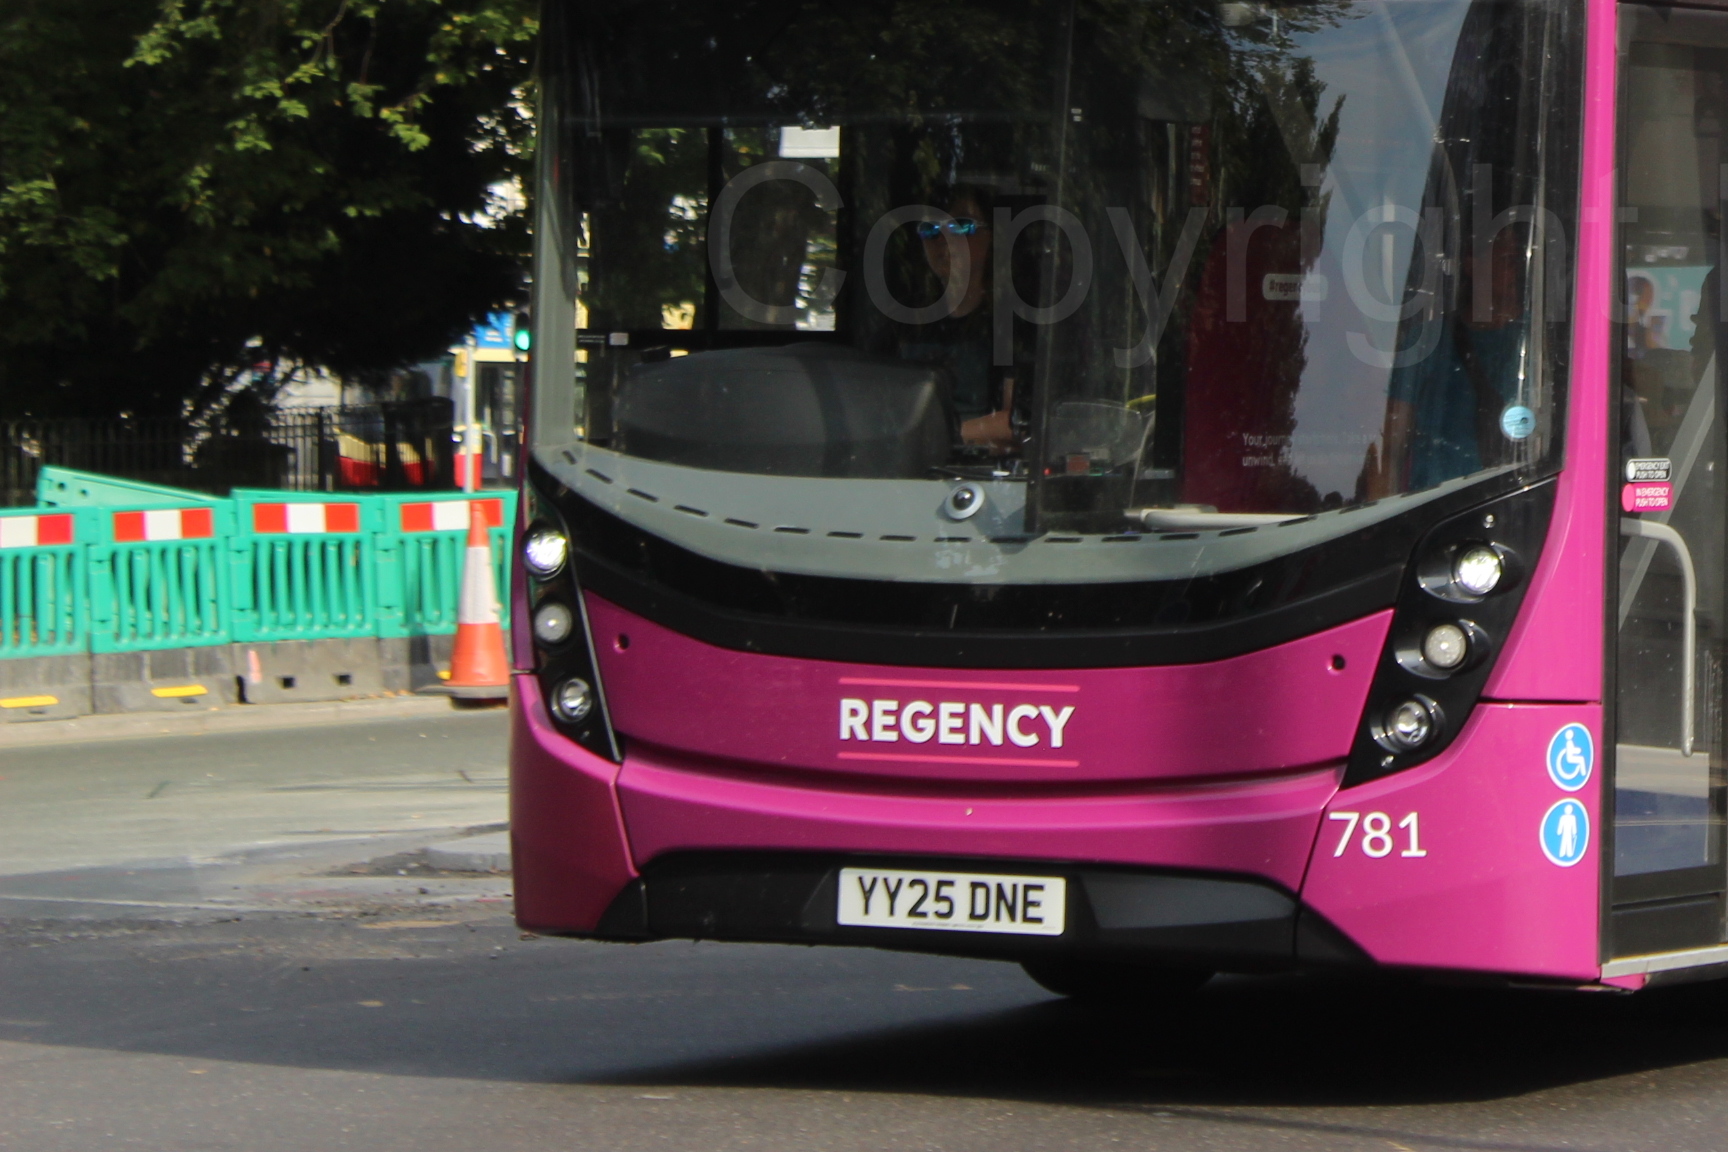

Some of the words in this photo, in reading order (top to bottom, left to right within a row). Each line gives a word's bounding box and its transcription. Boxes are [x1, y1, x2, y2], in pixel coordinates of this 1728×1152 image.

[838, 698, 1075, 748] REGENCY
[1328, 811, 1427, 859] 781
[858, 875, 956, 920] YY25
[968, 881, 1045, 924] DNE
